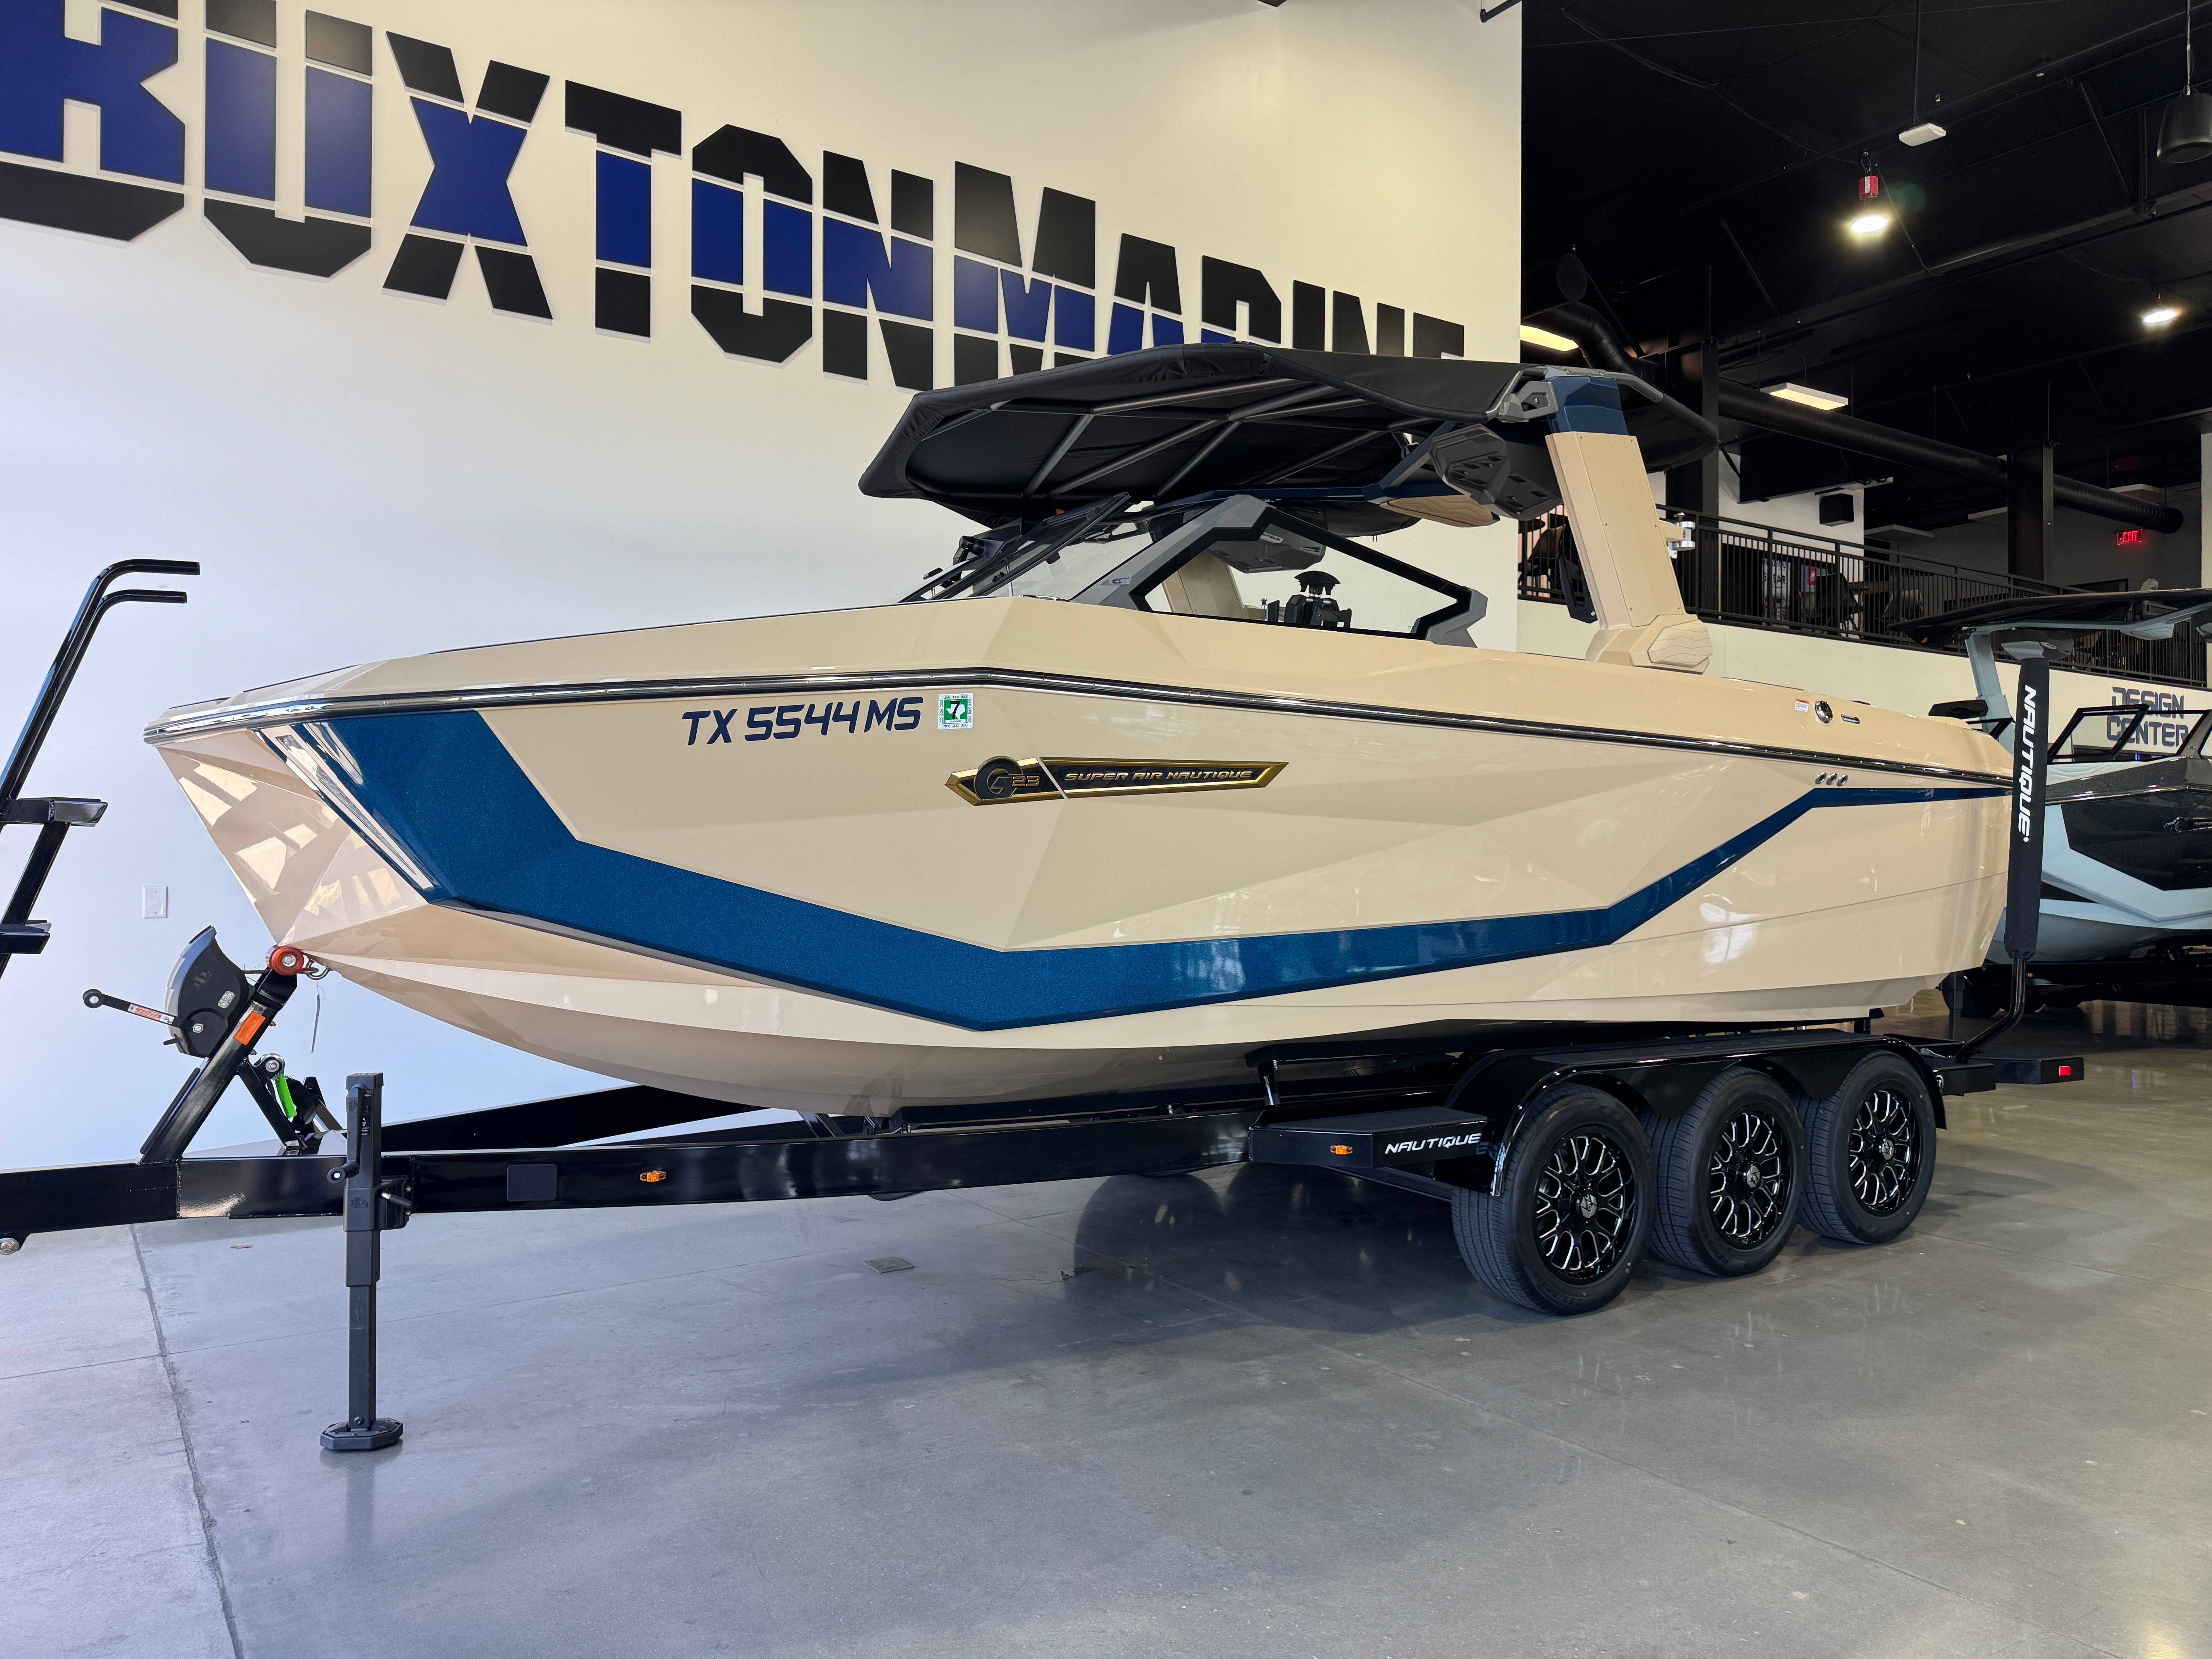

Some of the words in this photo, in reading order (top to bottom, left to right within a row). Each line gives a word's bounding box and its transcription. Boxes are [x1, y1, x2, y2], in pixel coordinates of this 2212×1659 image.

[950, 700, 960, 720] 7
[2112, 687, 2184, 719] DESIGN
[682, 708, 738, 745] TX
[744, 700, 861, 741] 5544
[864, 697, 924, 733] MS
[2107, 715, 2188, 747] CENTER
[1064, 773, 1129, 781] SUPER
[1132, 772, 1163, 780] AIR
[1166, 771, 1253, 780] NAUTIQUE
[2018, 684, 2036, 838] NAUTIQUE
[1384, 1133, 1482, 1154] NAUTIQUE
